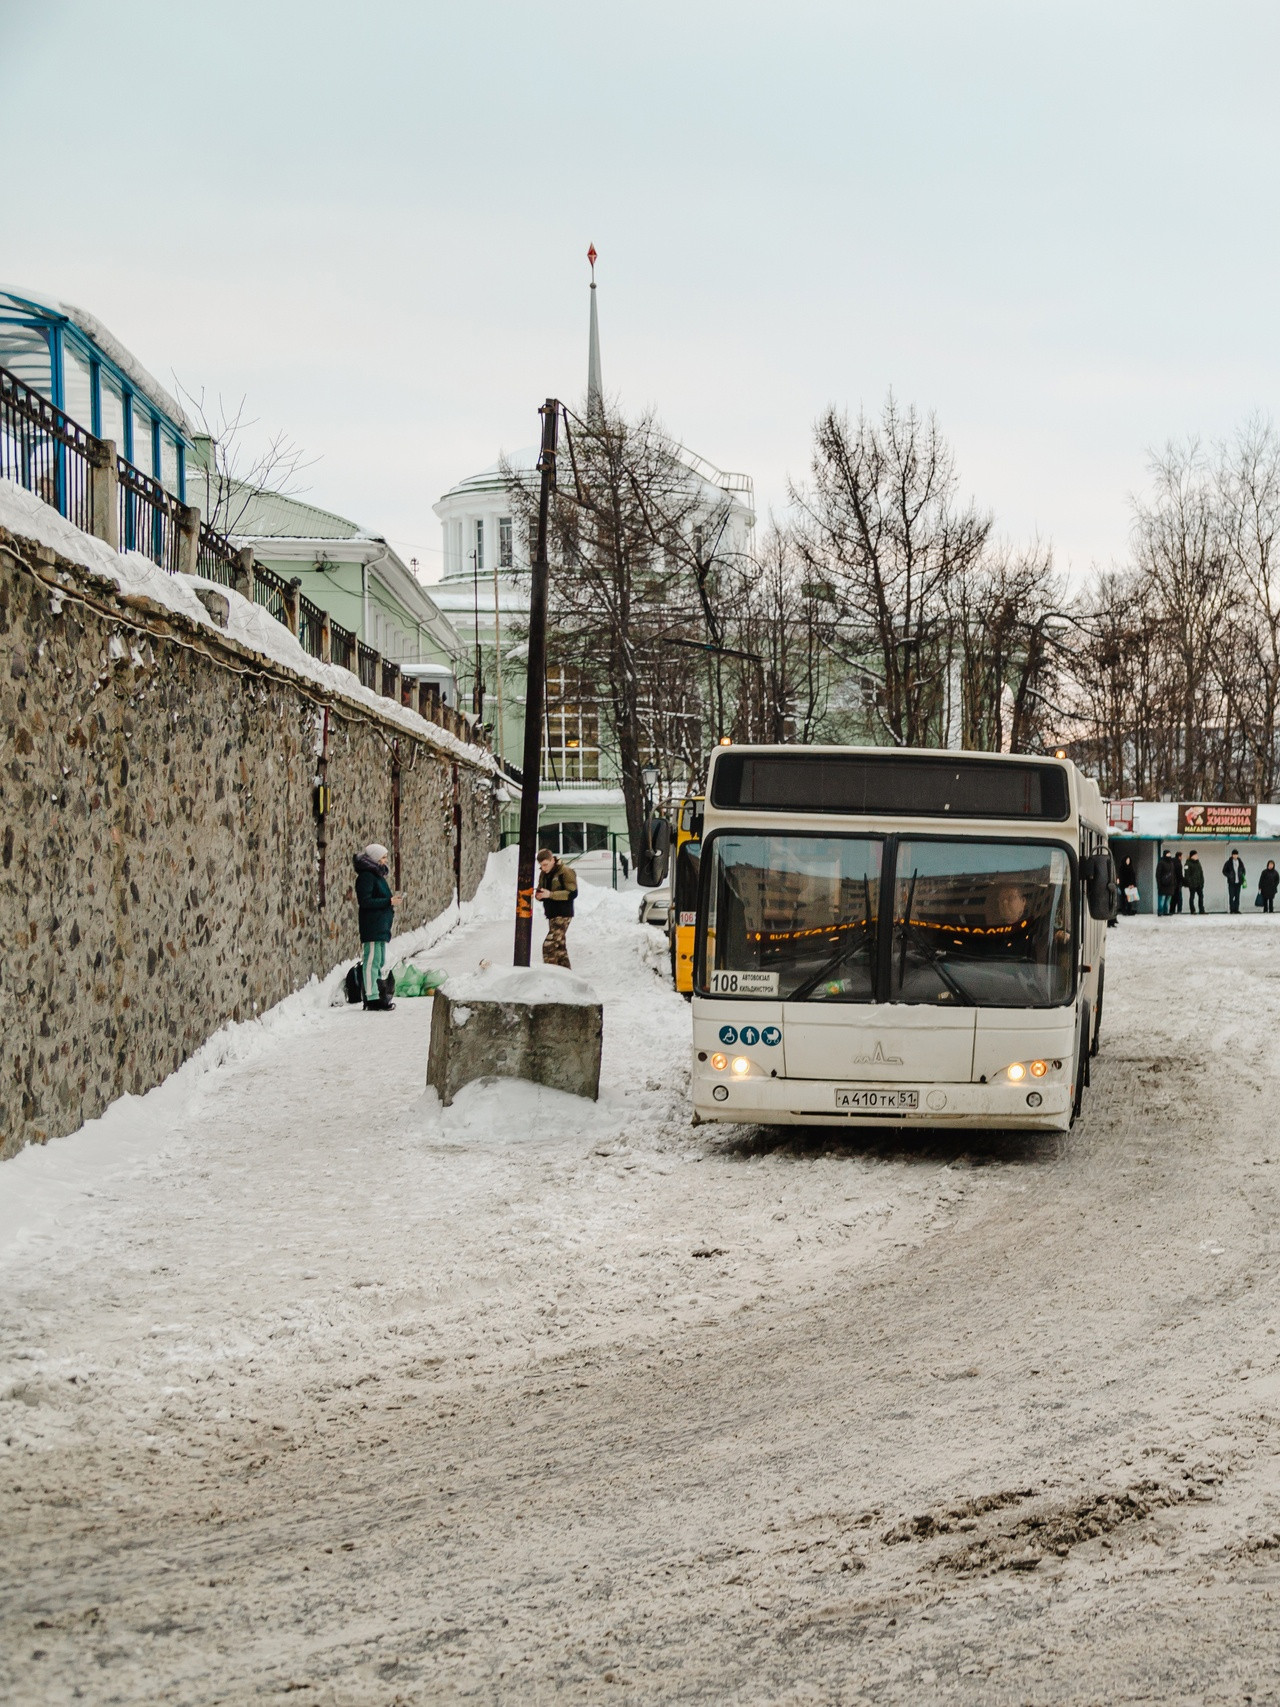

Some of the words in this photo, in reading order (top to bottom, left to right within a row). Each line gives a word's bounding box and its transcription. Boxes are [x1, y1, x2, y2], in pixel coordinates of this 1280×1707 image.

[1207, 807, 1251, 816] РЫБАЦКАЯ
[1206, 816, 1251, 826] ХИЖИНА
[712, 974, 738, 992] 108
